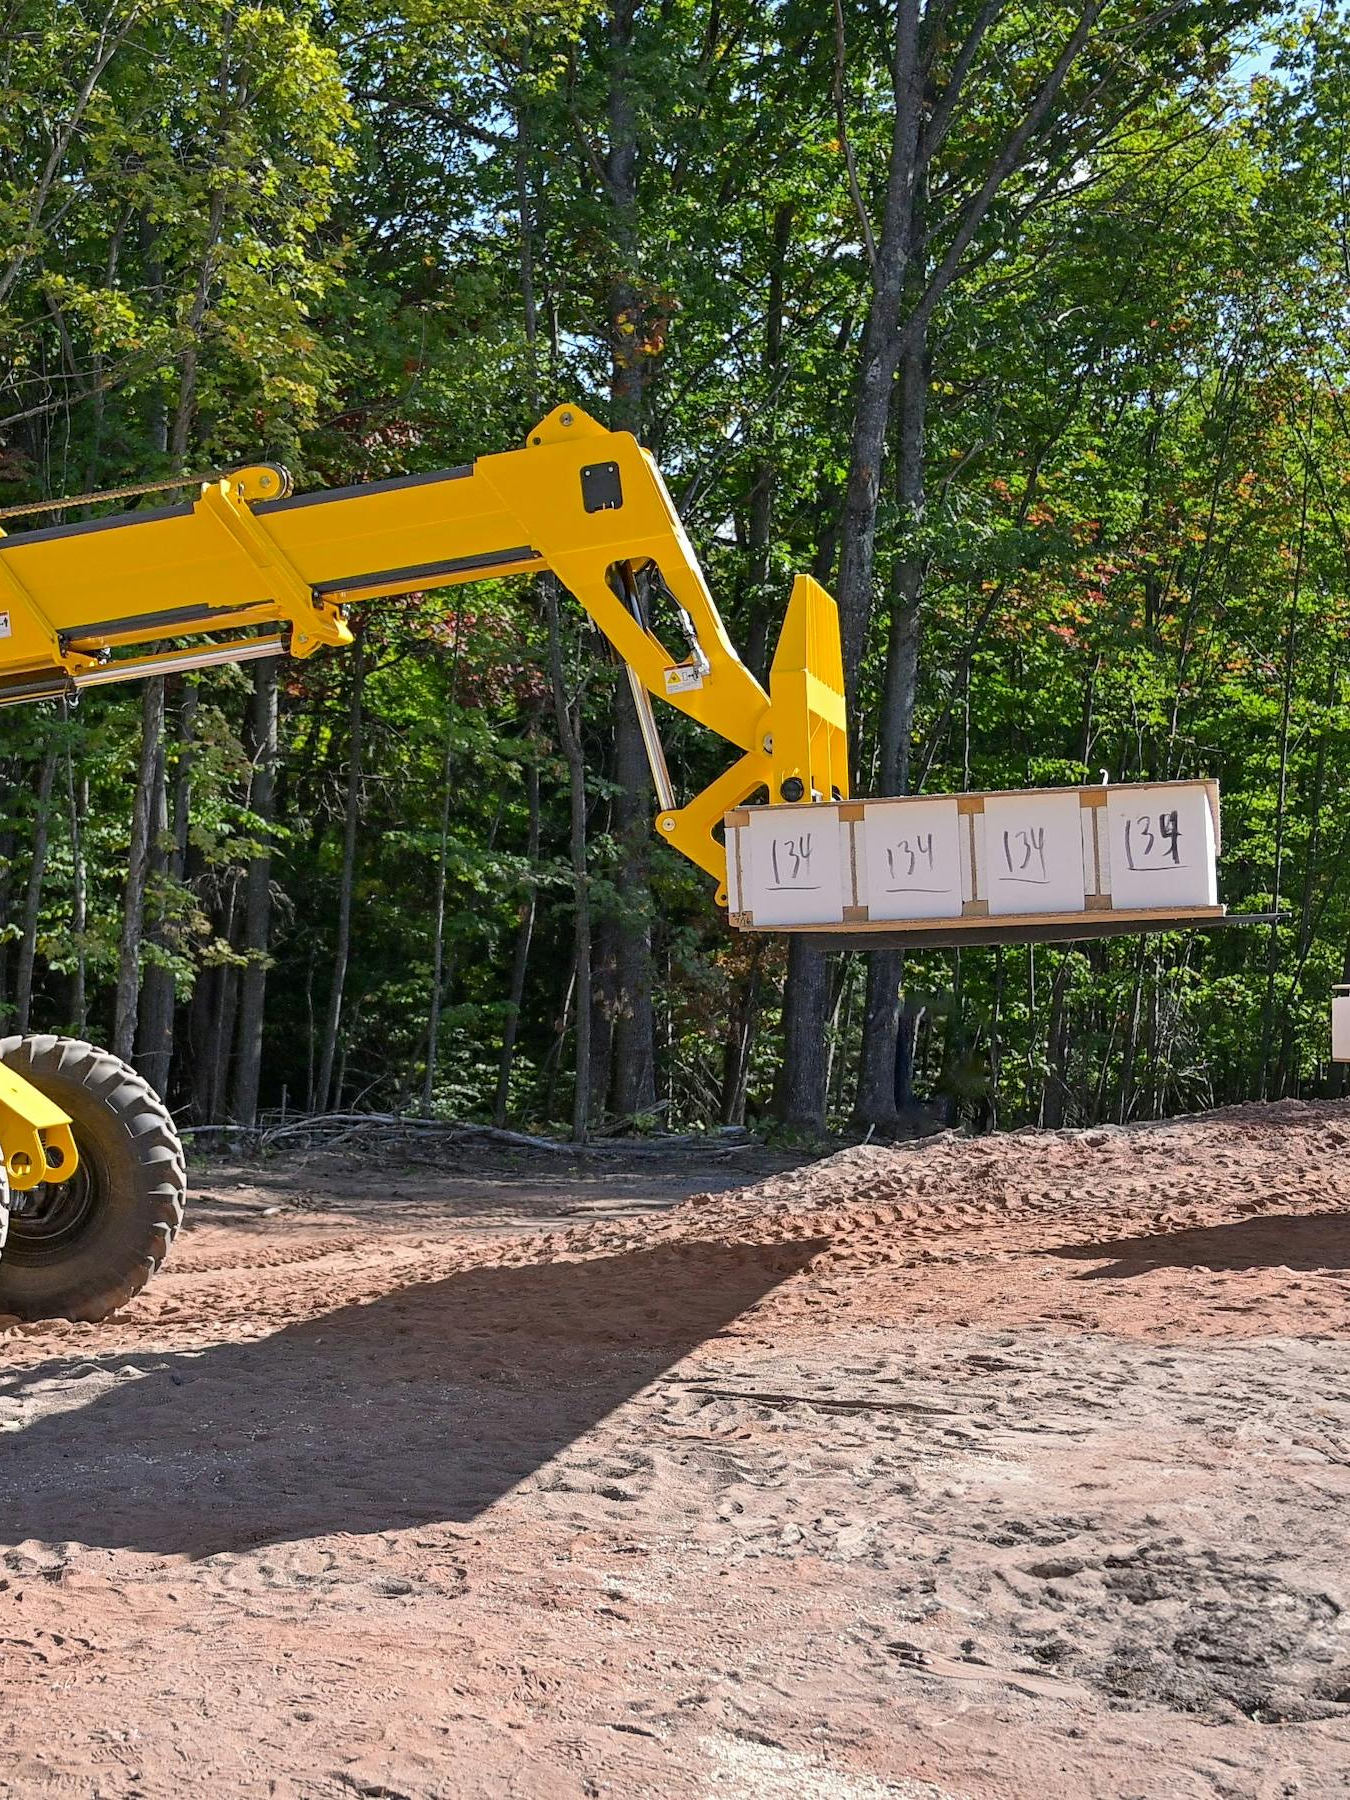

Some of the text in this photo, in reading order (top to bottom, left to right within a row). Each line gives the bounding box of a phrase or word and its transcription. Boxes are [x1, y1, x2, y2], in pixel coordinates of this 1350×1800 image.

[772, 832, 812, 884] 134
[888, 832, 934, 879] 134
[1003, 827, 1046, 880] 134
[1125, 810, 1182, 869] 134
